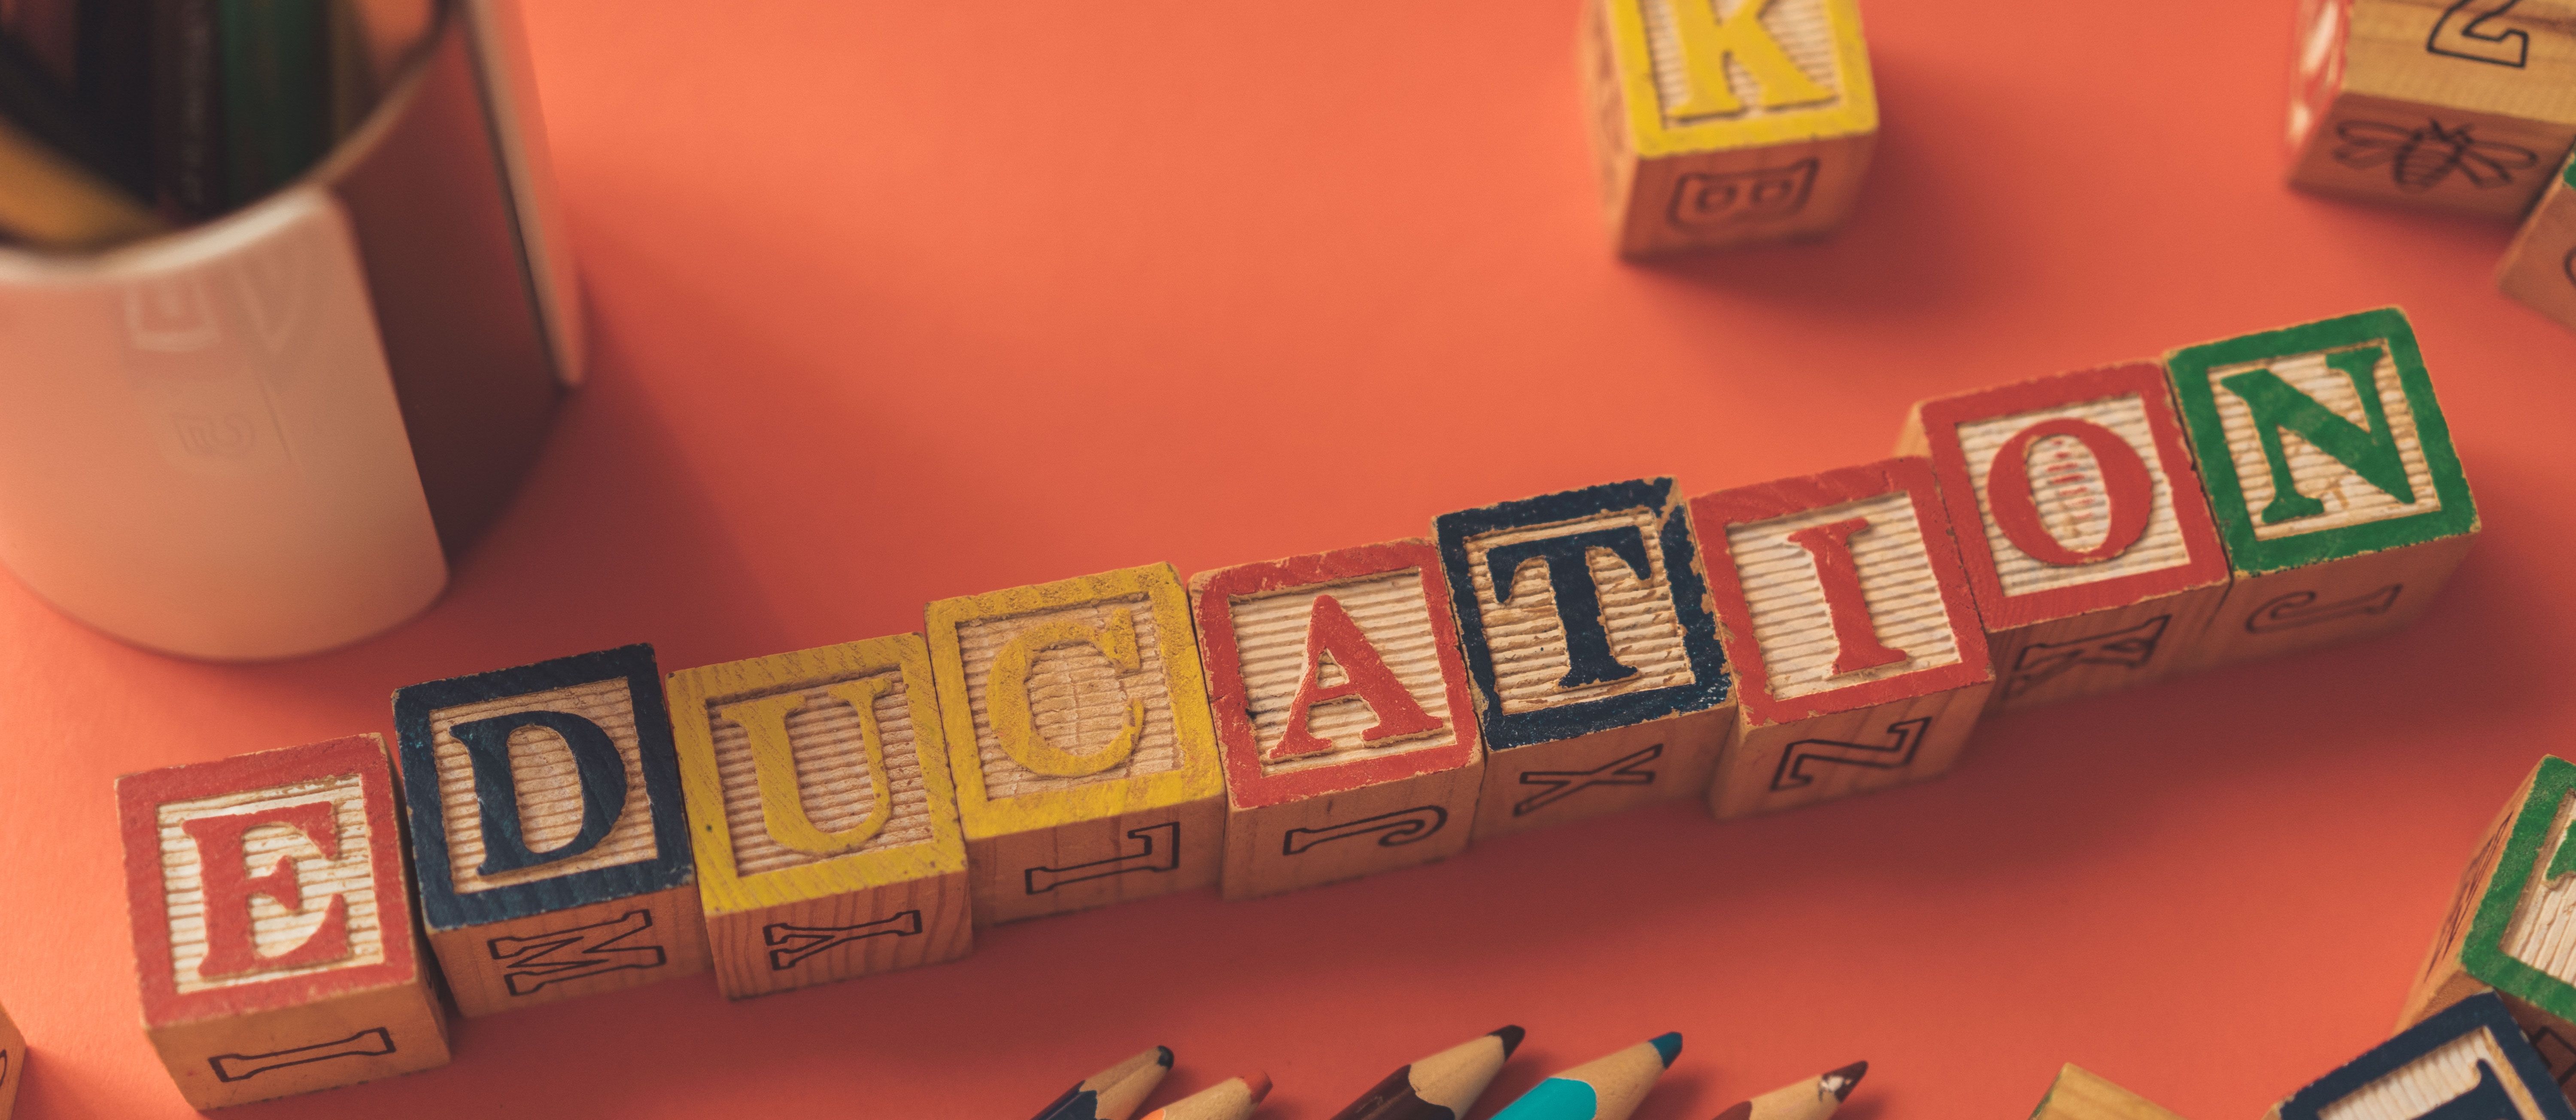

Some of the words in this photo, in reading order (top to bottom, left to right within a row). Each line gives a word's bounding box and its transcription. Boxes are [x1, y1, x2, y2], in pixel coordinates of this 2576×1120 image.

[180, 345, 2416, 977] EDUCATION
[1513, 743, 1663, 816] X
[1024, 821, 1180, 895] L
[1283, 805, 1448, 855] J
[763, 910, 922, 971] Y
